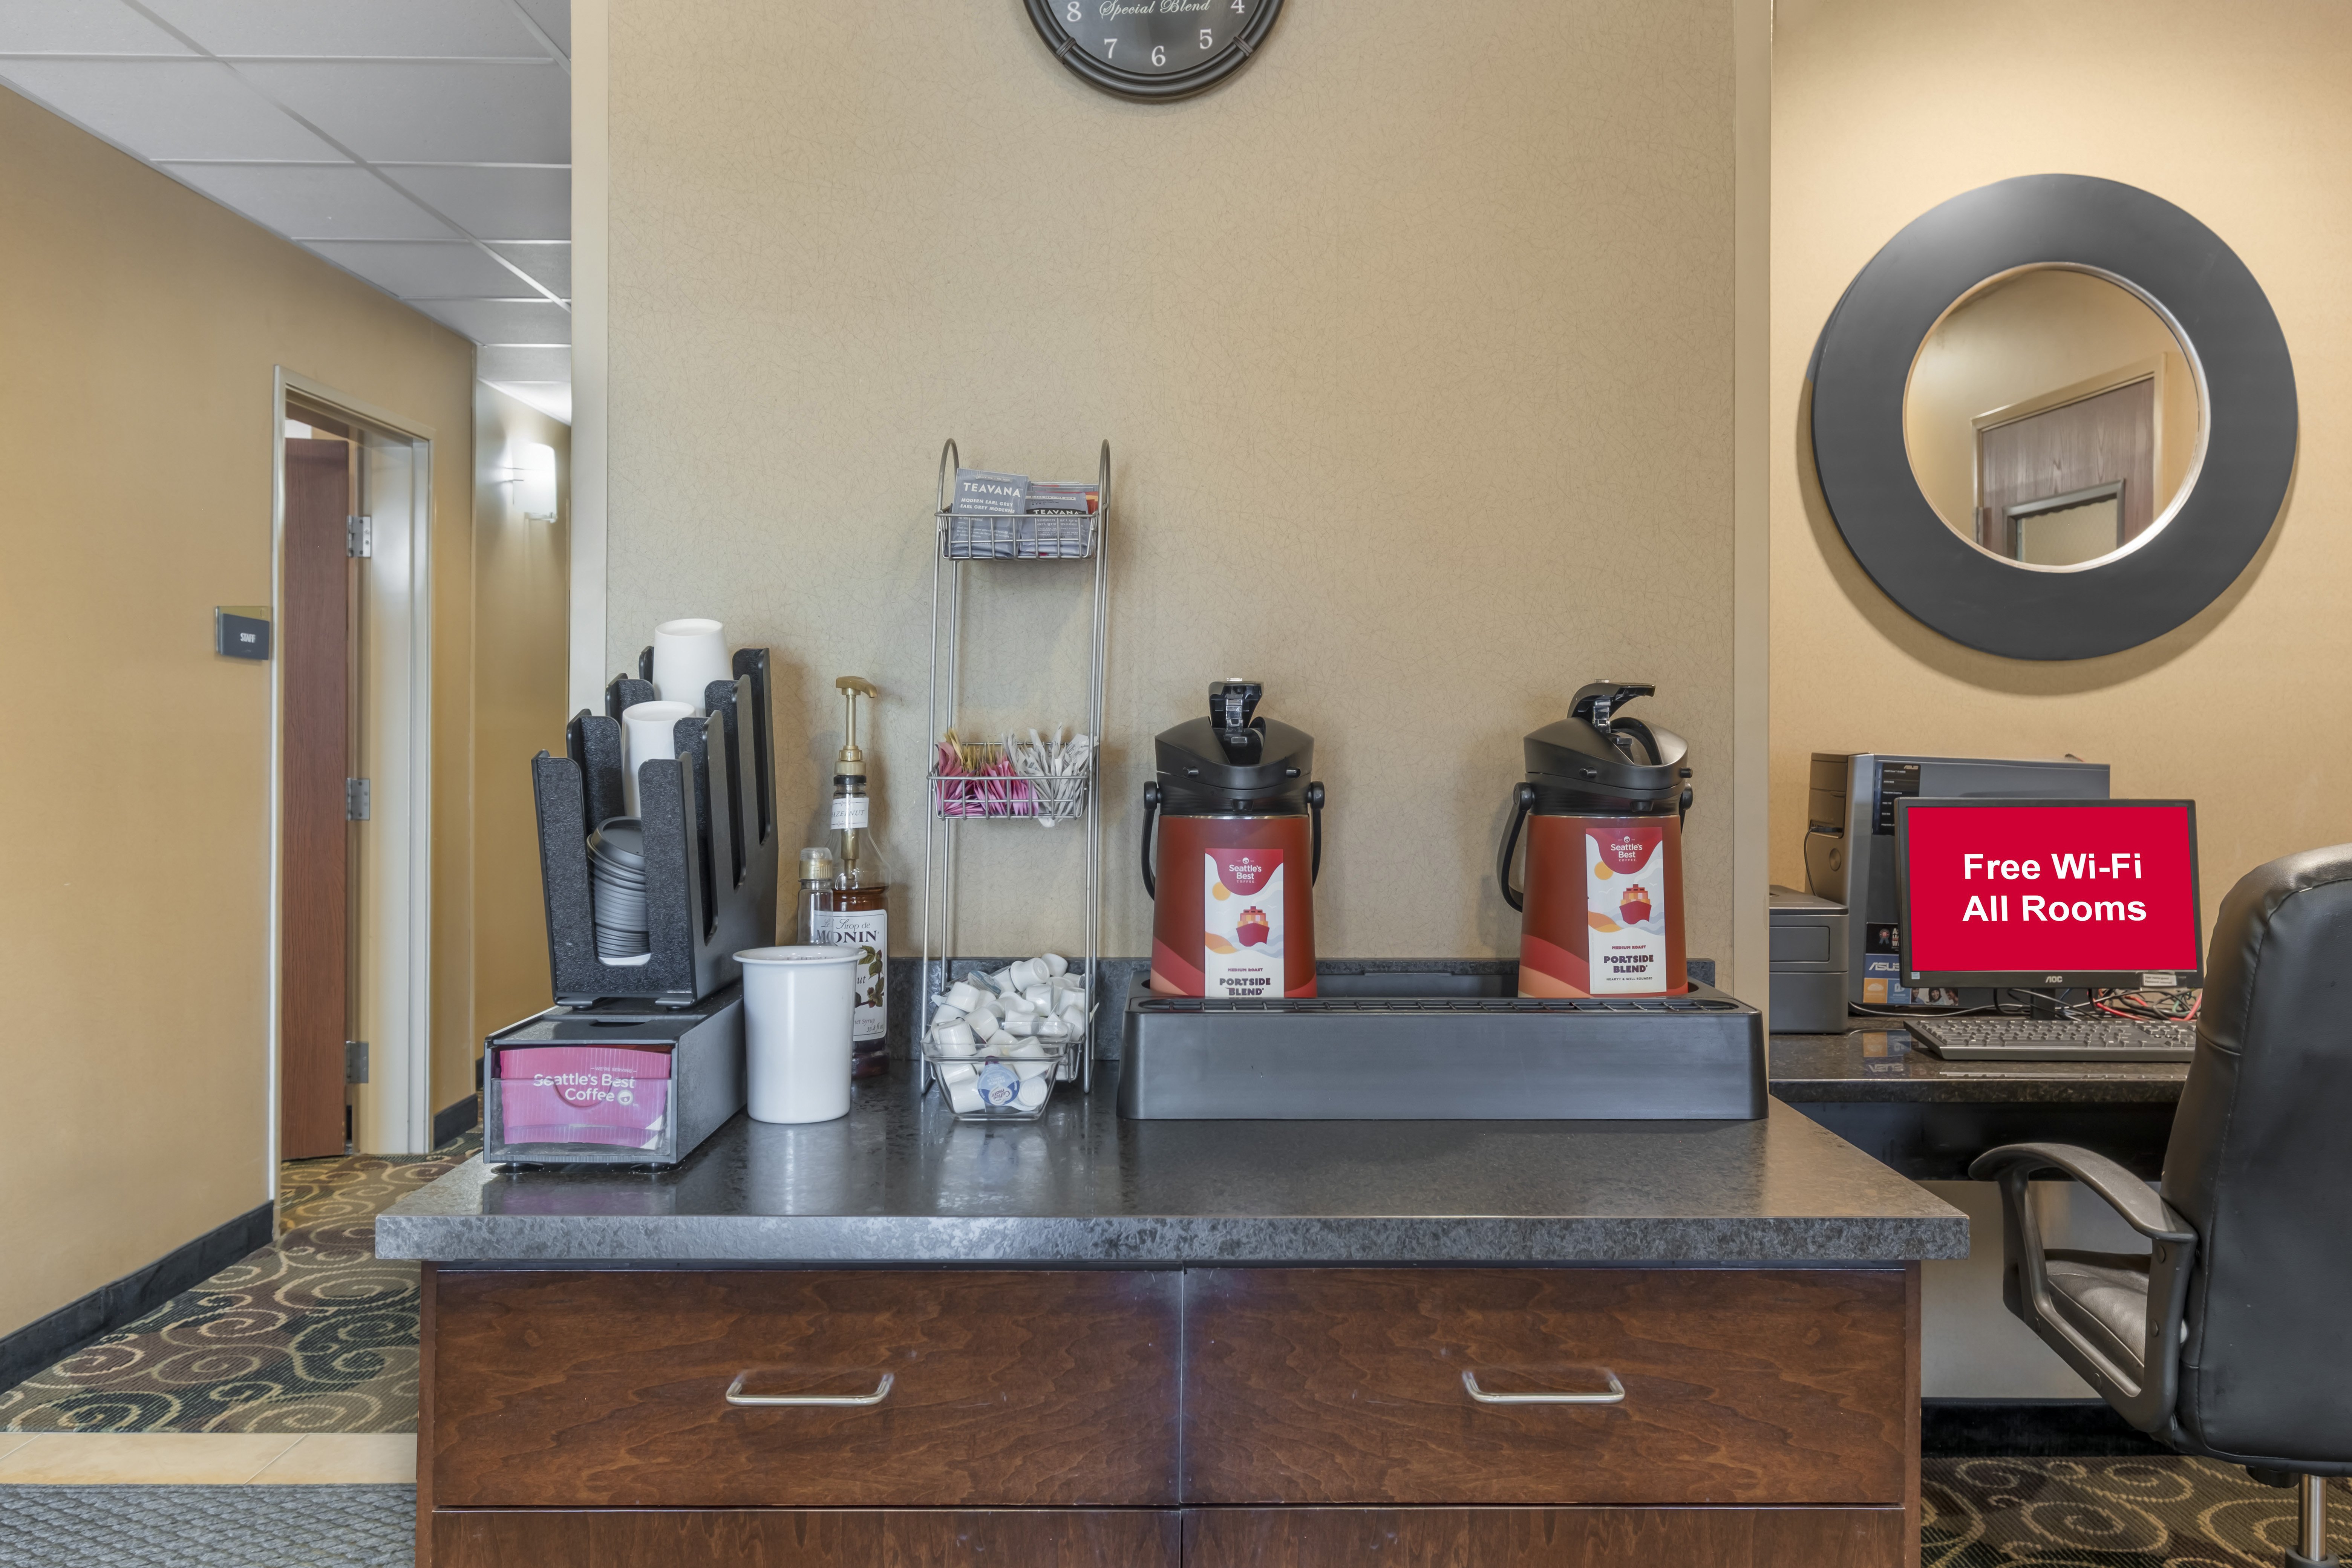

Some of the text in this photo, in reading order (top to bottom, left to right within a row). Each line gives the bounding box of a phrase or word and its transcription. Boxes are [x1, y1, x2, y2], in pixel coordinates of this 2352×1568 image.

[1067, 2, 1081, 22] 8
[1099, 0, 1210, 21] Special Blend
[1230, 0, 1245, 14] 4
[1200, 29, 1213, 49] 5
[1104, 38, 1118, 59] 7
[1152, 46, 1165, 66] 6
[963, 482, 1021, 498] TEAVANA
[240, 632, 256, 643] STAFF
[1964, 853, 2142, 880] Free Wi-Fi
[1962, 895, 2147, 922] All Rooms
[836, 919, 859, 931] Sirop
[816, 930, 877, 943] MONIN
[1604, 954, 1654, 963] PORTSIDE
[1869, 962, 1900, 971] ASUS
[533, 1073, 598, 1087] Seattle's
[602, 1073, 635, 1088] Best
[565, 1088, 615, 1102] Coffee
[992, 1089, 1004, 1098] mate
[993, 1090, 1010, 1100] Coffee
